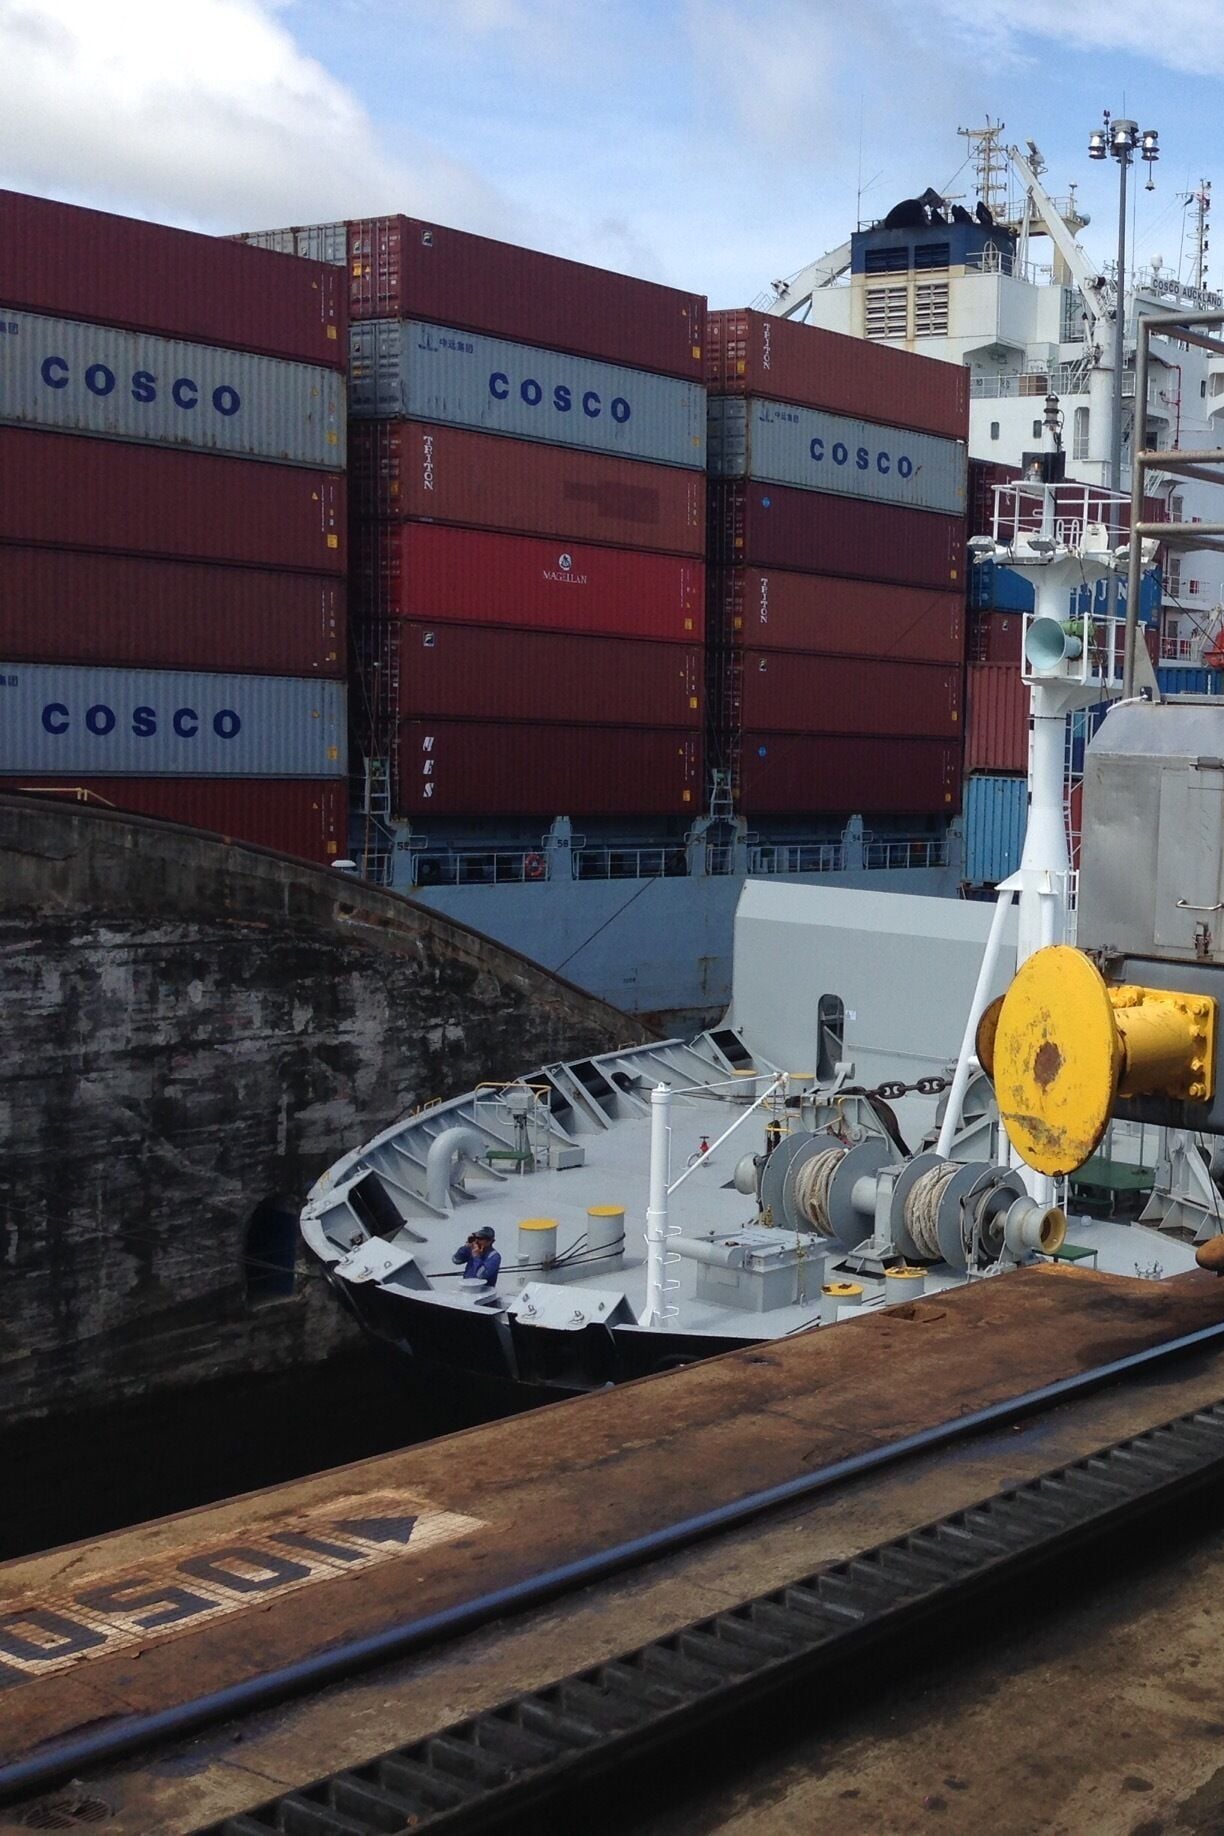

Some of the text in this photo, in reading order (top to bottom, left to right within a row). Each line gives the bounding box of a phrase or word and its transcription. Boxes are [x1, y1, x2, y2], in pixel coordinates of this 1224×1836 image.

[1152, 279, 1222, 307] COSCO AUCKLAND
[763, 322, 771, 370] TRITON
[40, 355, 242, 417] COSCO
[488, 371, 632, 424] COSCO
[423, 435, 433, 490] TRITON
[809, 437, 914, 479] COSCO
[543, 570, 588, 585] MAGELLAN
[760, 577, 769, 624] TRITON
[40, 702, 242, 739] COSCO
